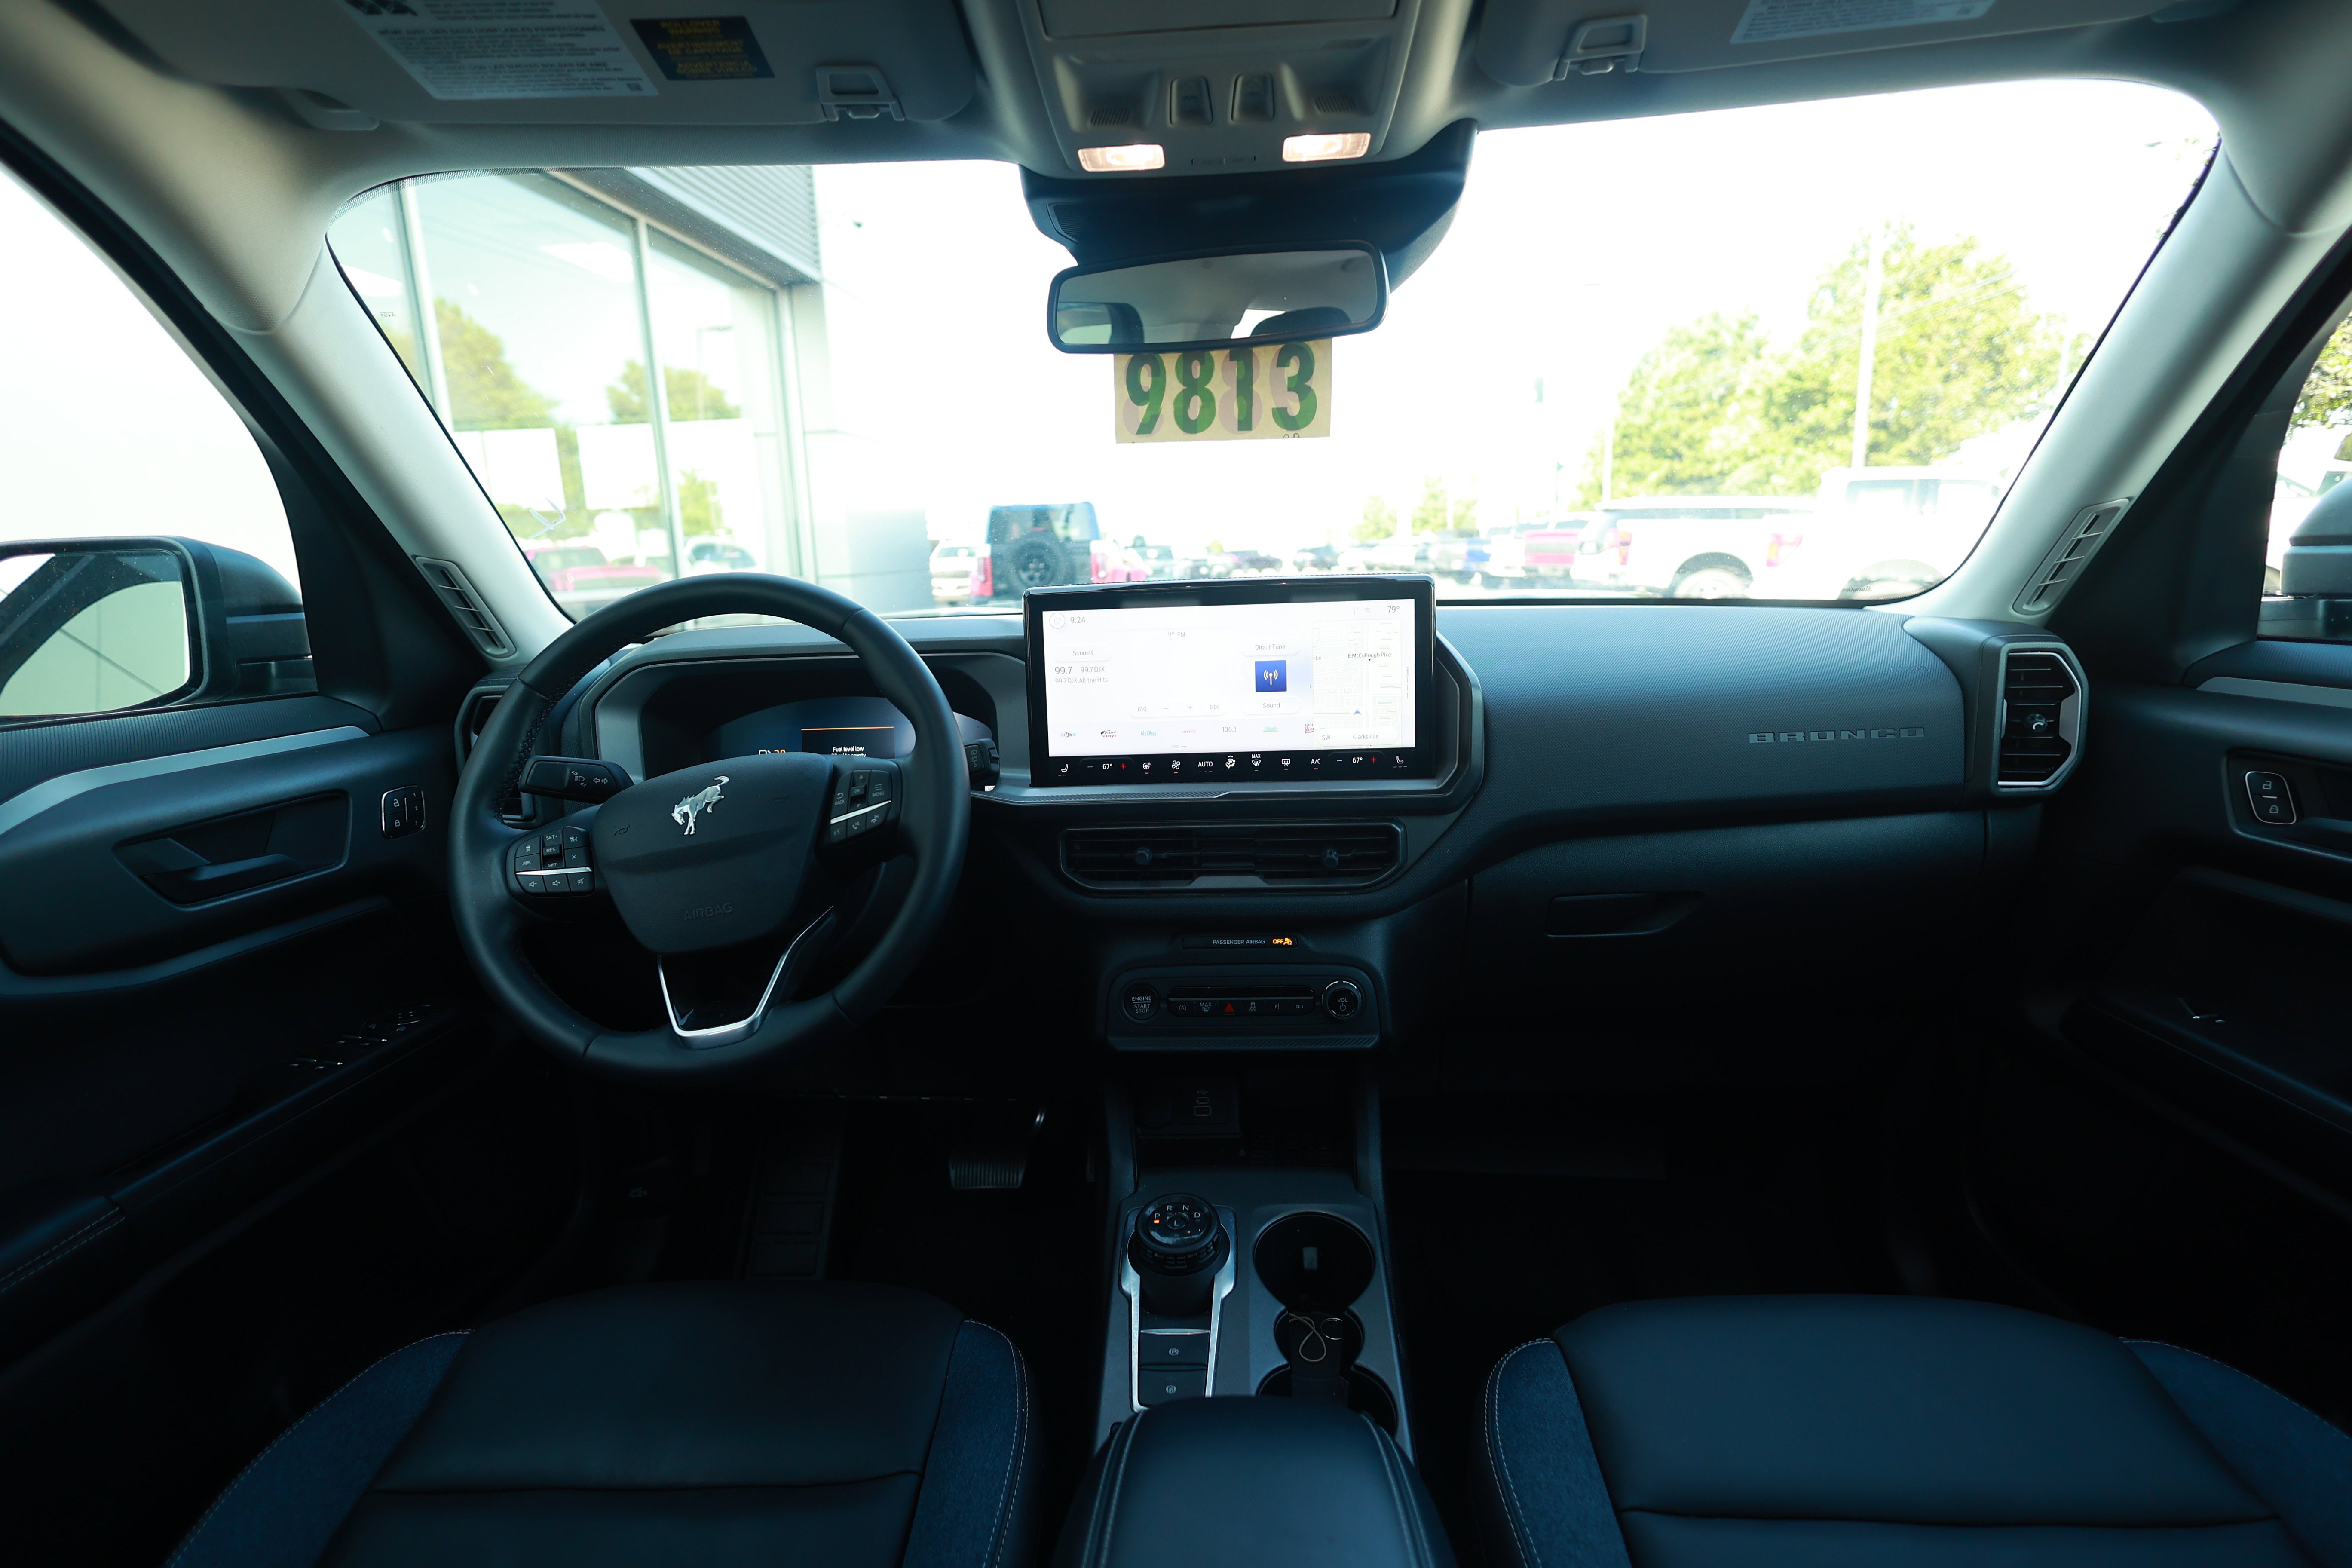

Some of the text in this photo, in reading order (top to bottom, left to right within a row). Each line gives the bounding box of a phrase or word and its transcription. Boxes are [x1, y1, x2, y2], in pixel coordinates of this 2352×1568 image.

[1126, 341, 1317, 435] 9813
[1749, 727, 1925, 744] BRONCO
[684, 902, 733, 921] AIRBAG
